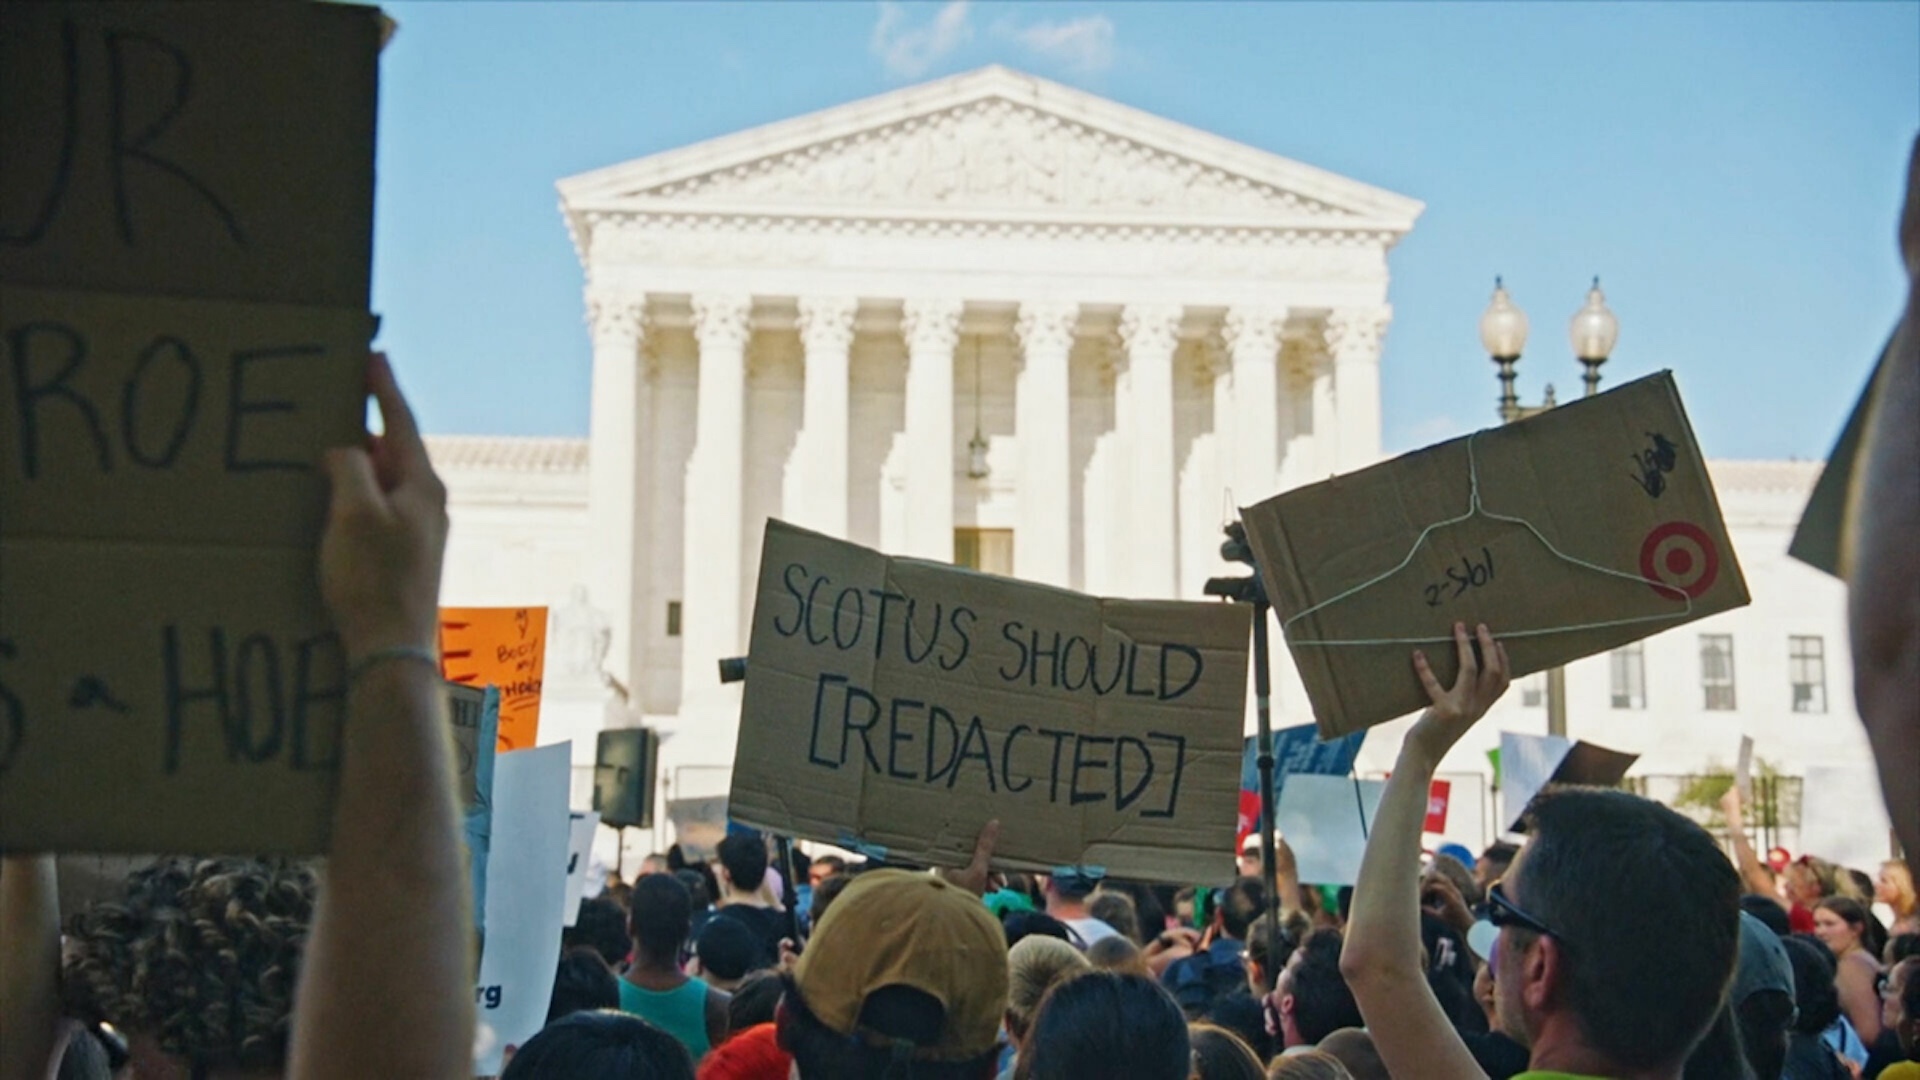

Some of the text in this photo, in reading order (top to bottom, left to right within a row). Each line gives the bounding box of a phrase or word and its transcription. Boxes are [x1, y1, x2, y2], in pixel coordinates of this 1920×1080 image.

[5, 321, 327, 480] ROE
[774, 563, 1204, 700] SCOTUS SHOULD
[808, 673, 1186, 818] [REDACTED]
